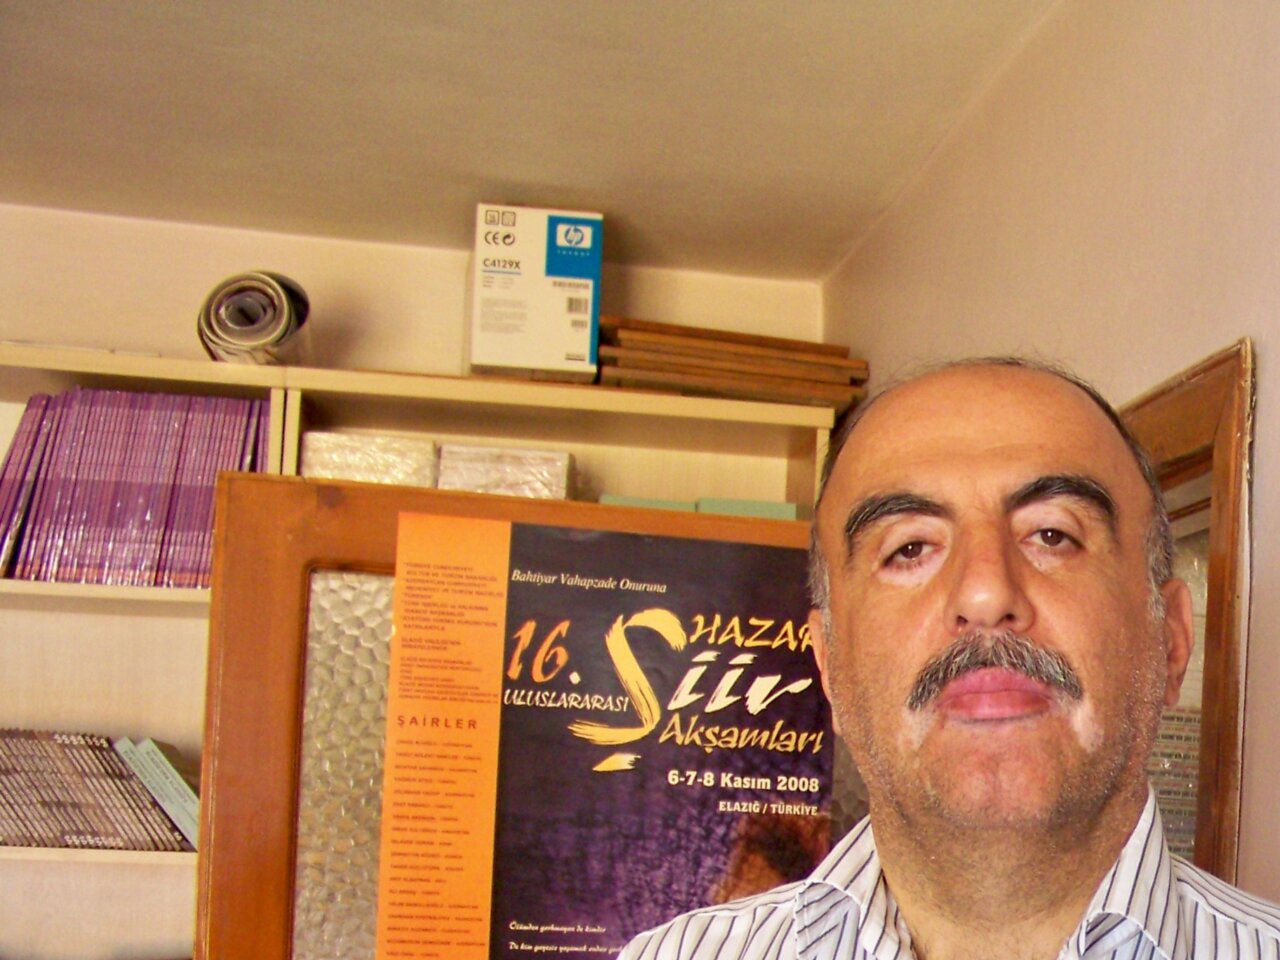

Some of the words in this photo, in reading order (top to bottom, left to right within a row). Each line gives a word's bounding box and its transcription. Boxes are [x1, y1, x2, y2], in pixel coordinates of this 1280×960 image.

[482, 257, 521, 271] C4129X
[511, 569, 557, 586] Bahtiyar
[560, 573, 617, 590] Vahapzade
[619, 578, 667, 593] Onuruna
[689, 613, 813, 653] HAZAR
[507, 620, 581, 685] 16.
[504, 689, 629, 712] ULUSLARARASI
[397, 715, 477, 730] ŞAİRLER
[659, 713, 825, 754] Akşamları
[667, 769, 715, 787] 6-7-8
[720, 772, 771, 790] Kasım
[776, 776, 819, 792] 2008
[719, 801, 760, 813] ELAZIĞ
[770, 802, 818, 816] TÜRKİYE
